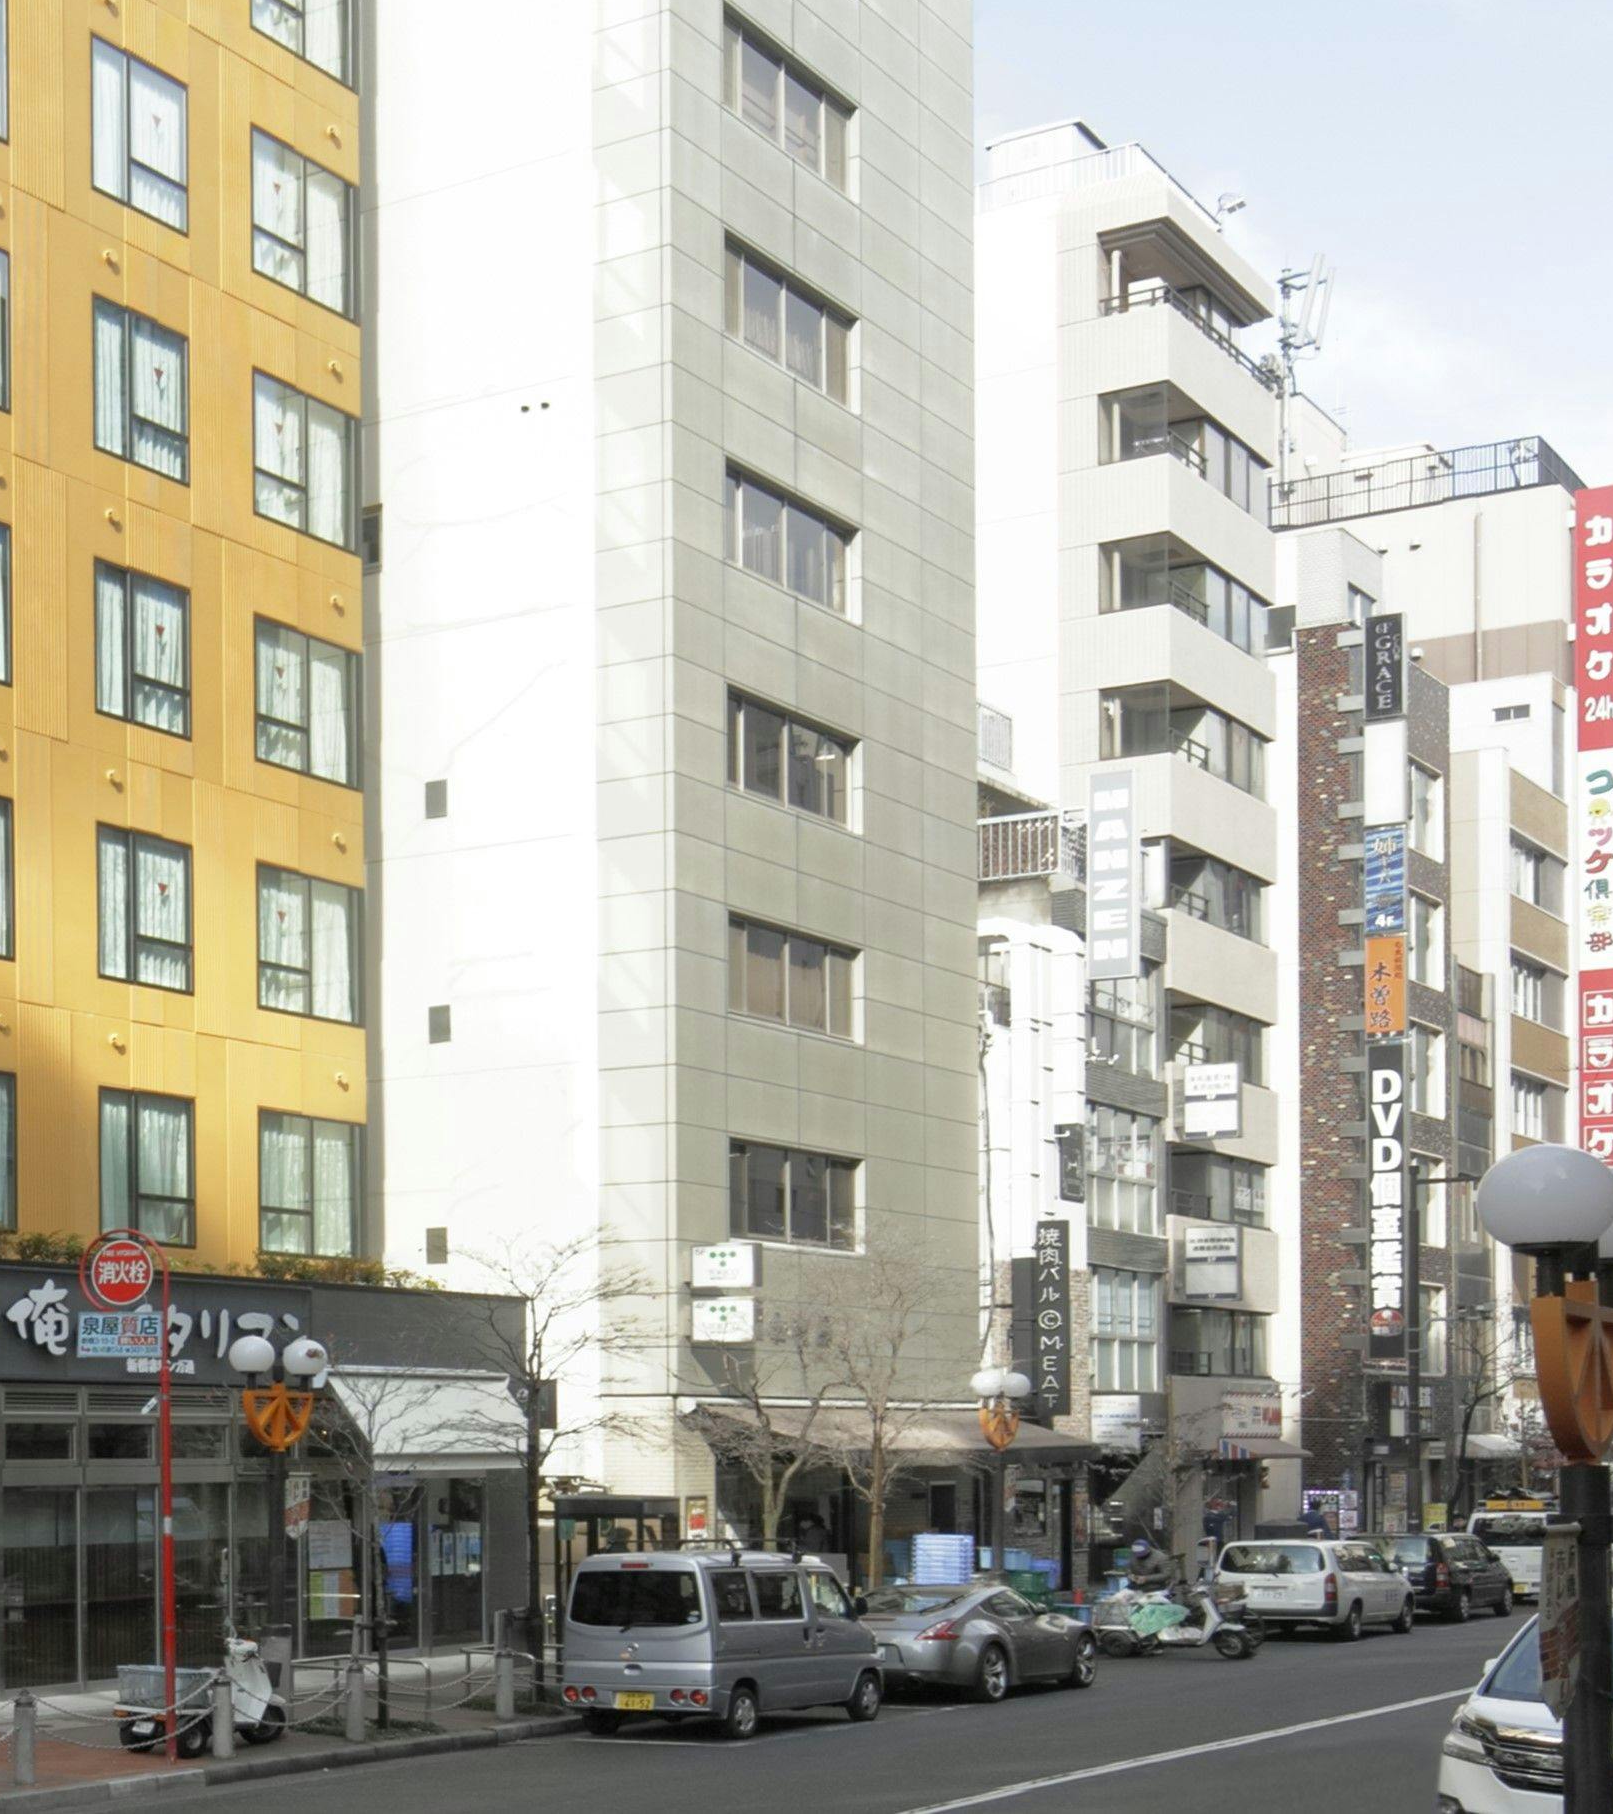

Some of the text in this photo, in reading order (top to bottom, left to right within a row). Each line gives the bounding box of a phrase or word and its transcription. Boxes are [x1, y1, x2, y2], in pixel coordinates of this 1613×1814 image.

[1585, 514, 1613, 681] カラオケ
[1375, 635, 1394, 710] GRACE
[97, 1259, 148, 1285] 消火栓
[1037, 1227, 1064, 1304] 焼肉バル
[81, 1316, 159, 1336] 泉屋質店
